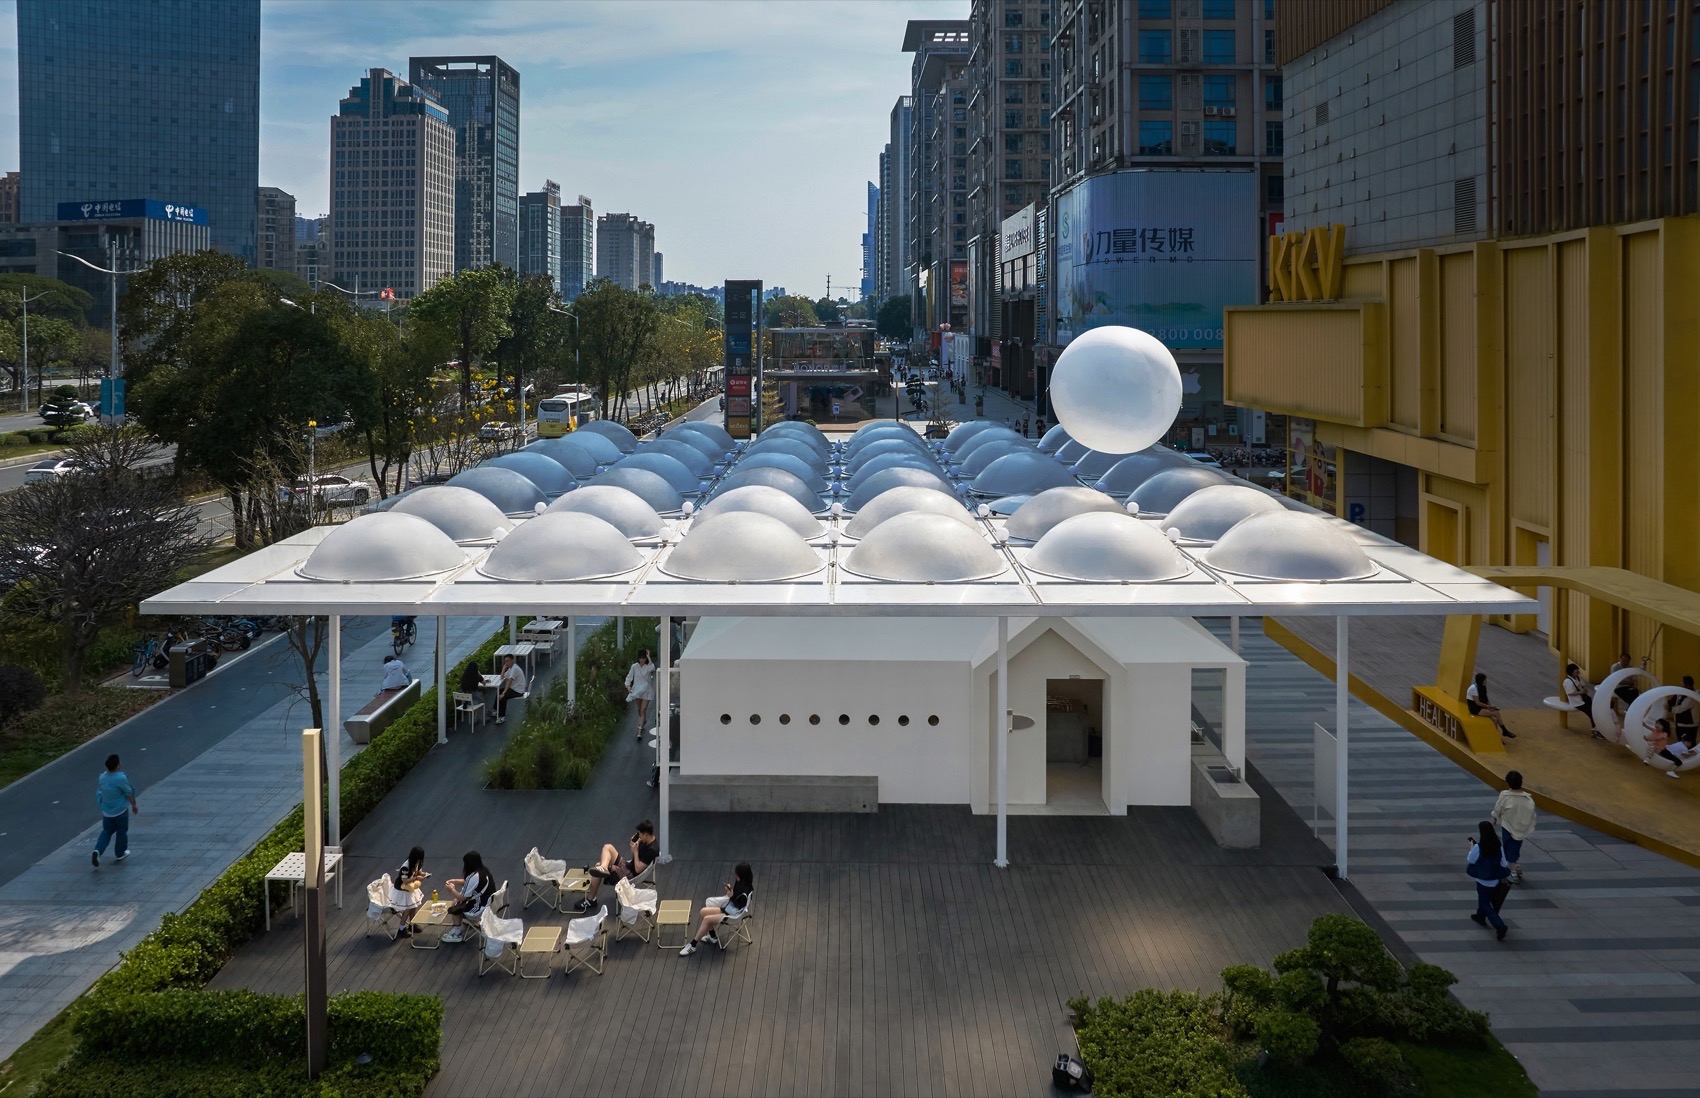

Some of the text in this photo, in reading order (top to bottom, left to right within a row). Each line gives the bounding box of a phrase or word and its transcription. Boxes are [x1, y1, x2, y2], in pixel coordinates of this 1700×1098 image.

[94, 202, 121, 214] 中国电信
[174, 206, 194, 218] 中国电信
[1096, 227, 1195, 255] 力量传媒
[1269, 224, 1346, 304] KKV
[794, 364, 830, 372] HONOR
[1420, 695, 1457, 740] HEALTH
